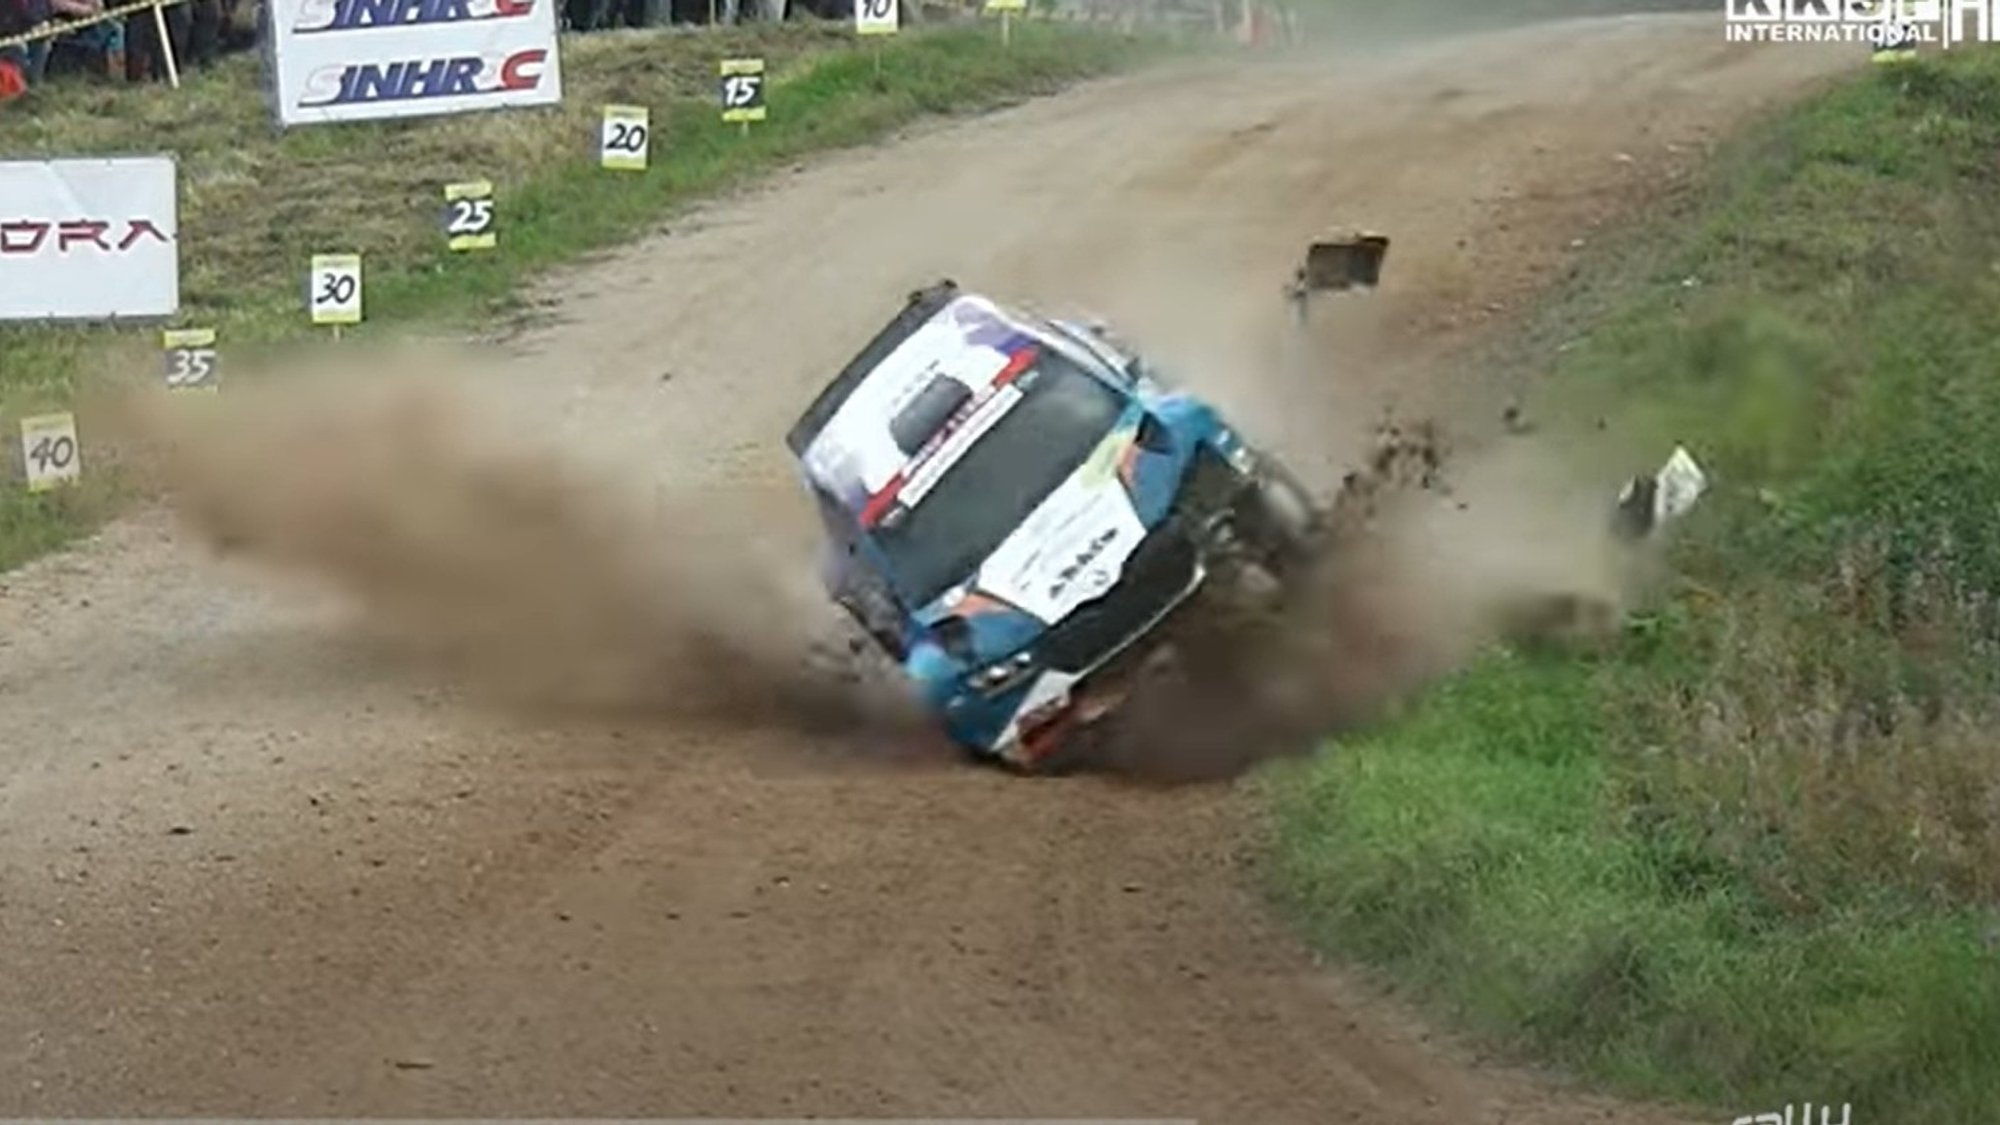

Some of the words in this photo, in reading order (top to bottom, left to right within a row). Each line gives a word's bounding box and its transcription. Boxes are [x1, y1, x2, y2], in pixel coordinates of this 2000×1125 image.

[863, 0, 892, 19] 10
[725, 76, 761, 106] 15
[605, 123, 646, 153] 20
[448, 200, 494, 232] 25
[316, 272, 355, 304] 30
[168, 349, 216, 383] 35
[30, 436, 74, 475] 40
